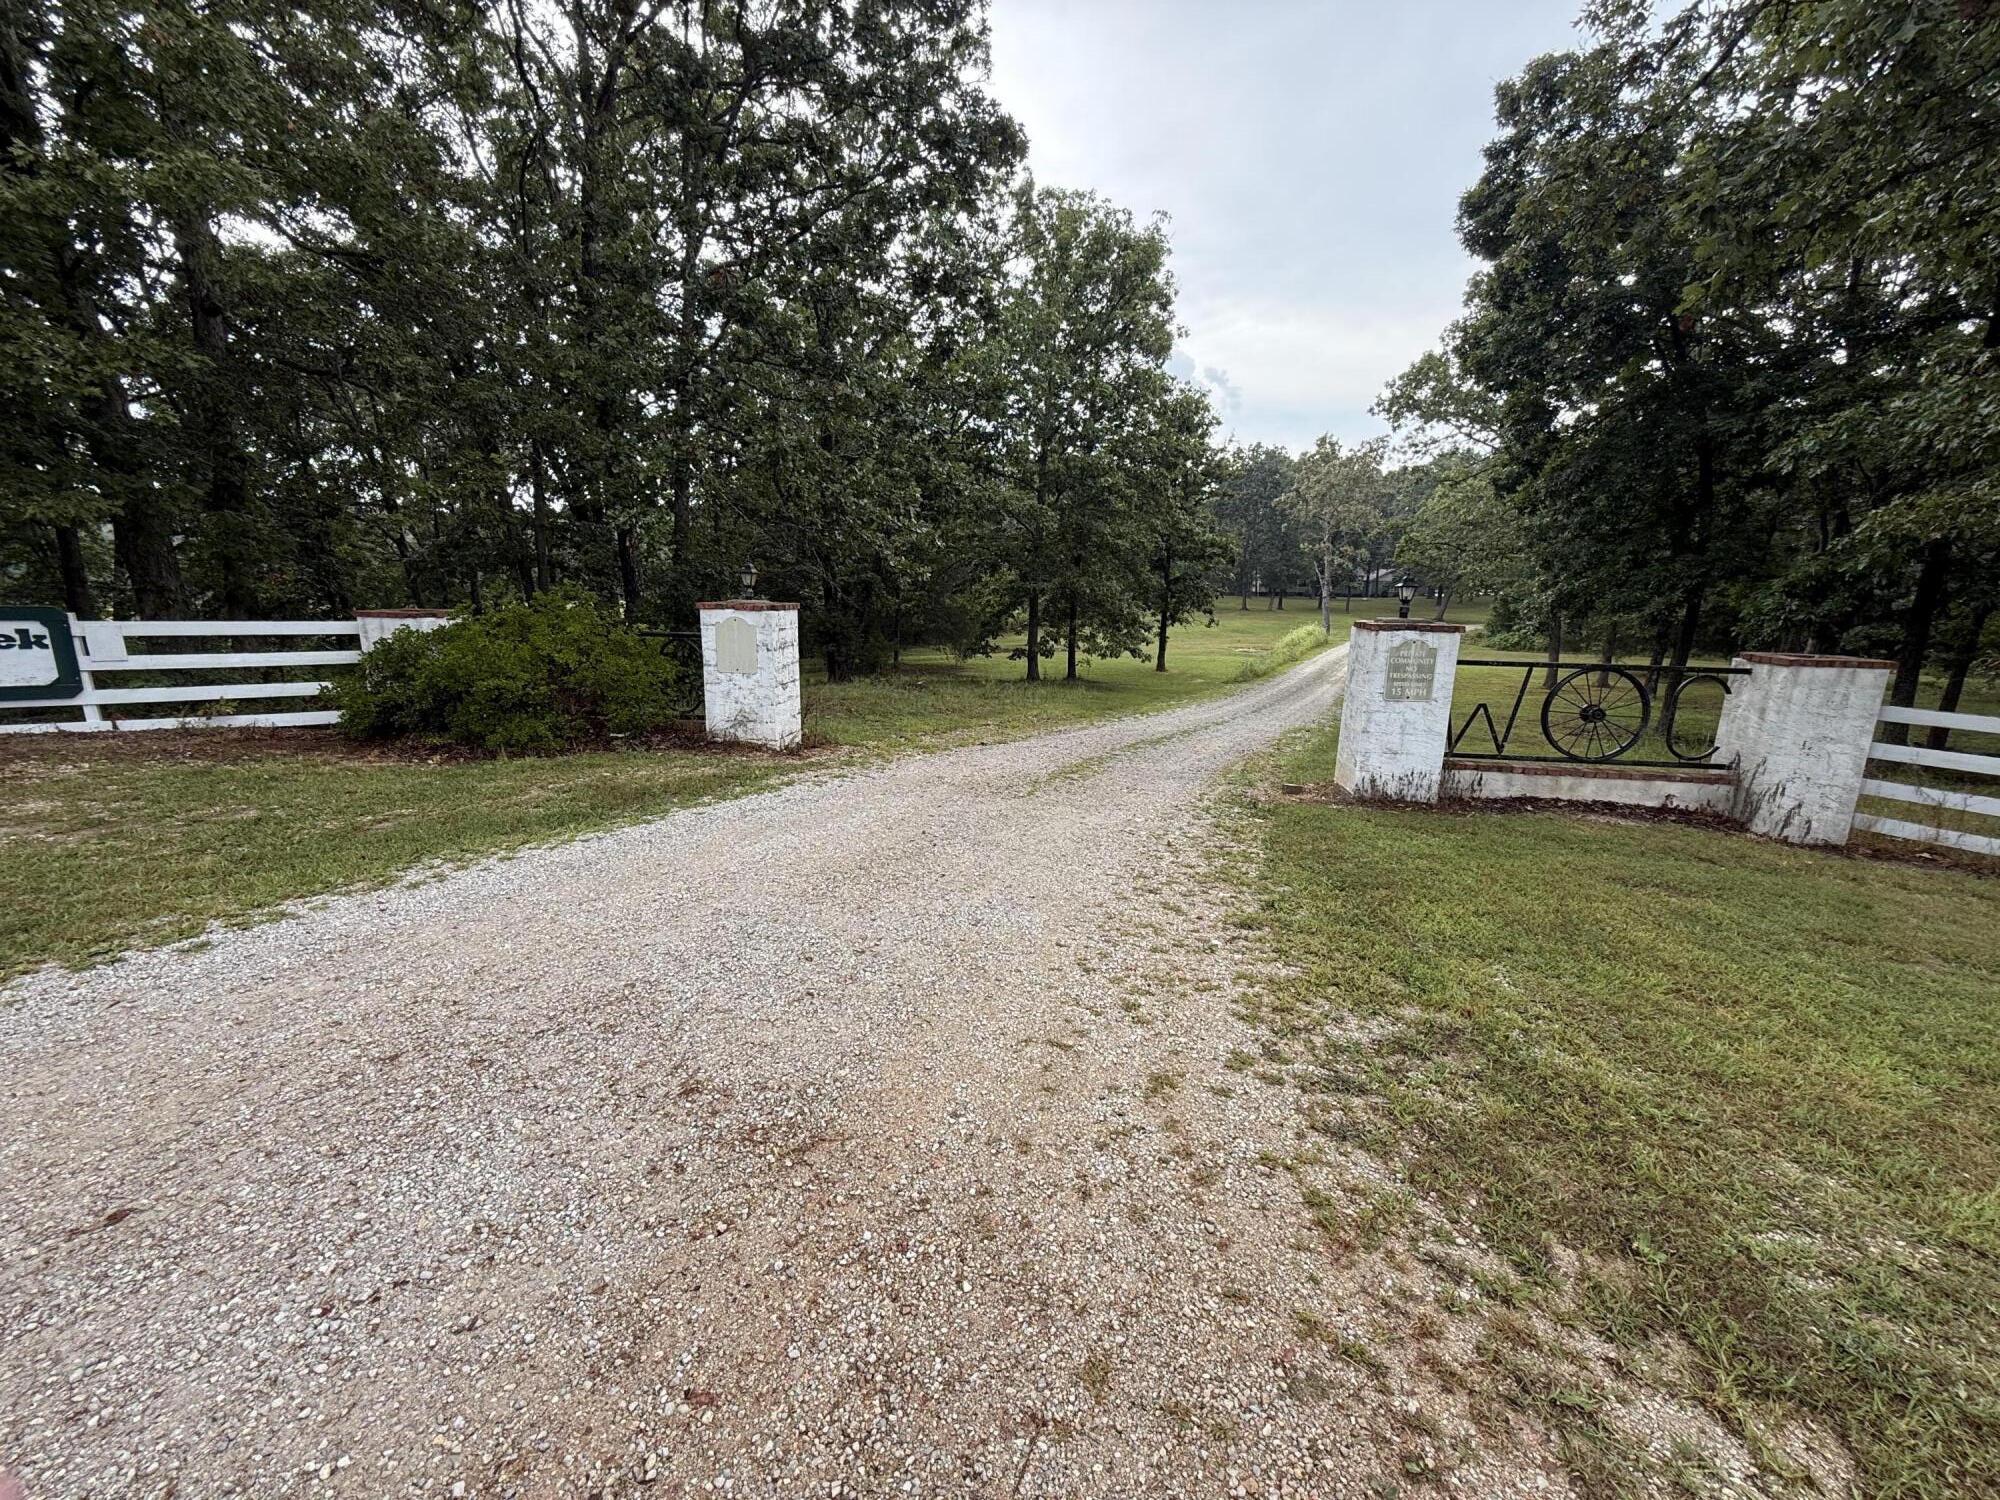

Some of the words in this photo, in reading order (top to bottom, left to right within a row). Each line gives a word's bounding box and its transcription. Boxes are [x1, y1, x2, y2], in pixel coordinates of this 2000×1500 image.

[1390, 657, 1434, 665] COMMUNITY
[1391, 688, 1401, 696] 15
[1405, 688, 1427, 696] MPH
